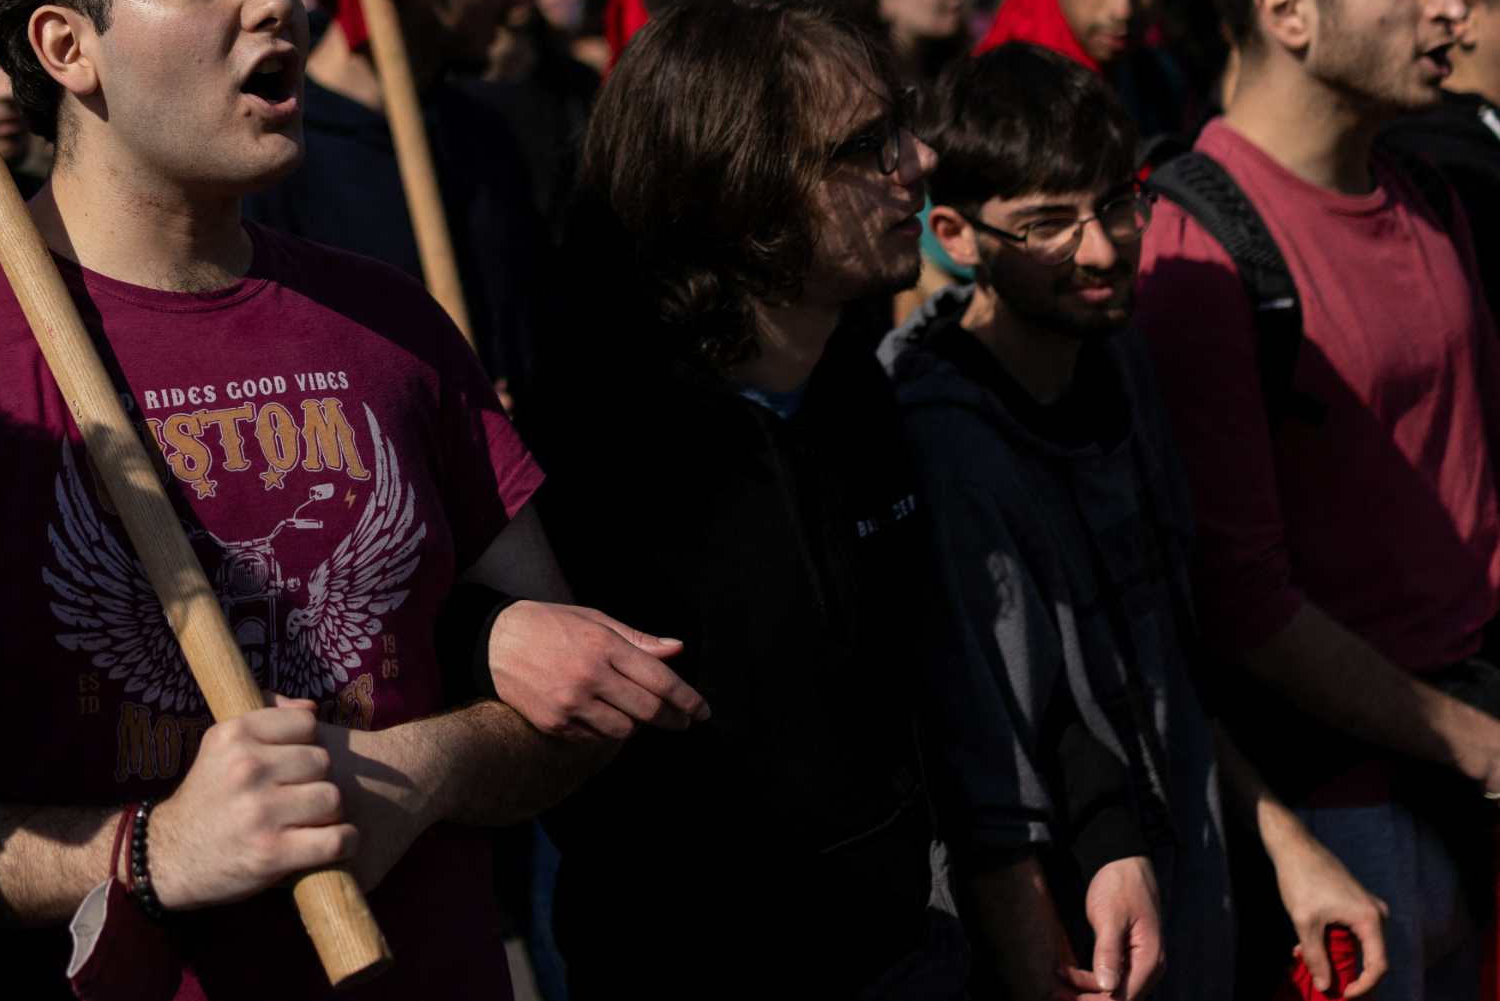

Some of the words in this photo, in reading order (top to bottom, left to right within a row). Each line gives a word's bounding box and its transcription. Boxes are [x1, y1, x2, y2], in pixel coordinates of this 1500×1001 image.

[144, 383, 217, 410] RIDES
[225, 374, 287, 401] GOOD
[294, 370, 350, 392] VIBES
[86, 397, 371, 515] USTOM
[381, 633, 397, 655] 19
[381, 658, 400, 680] 05
[78, 671, 101, 693] ES
[77, 694, 101, 716] TD
